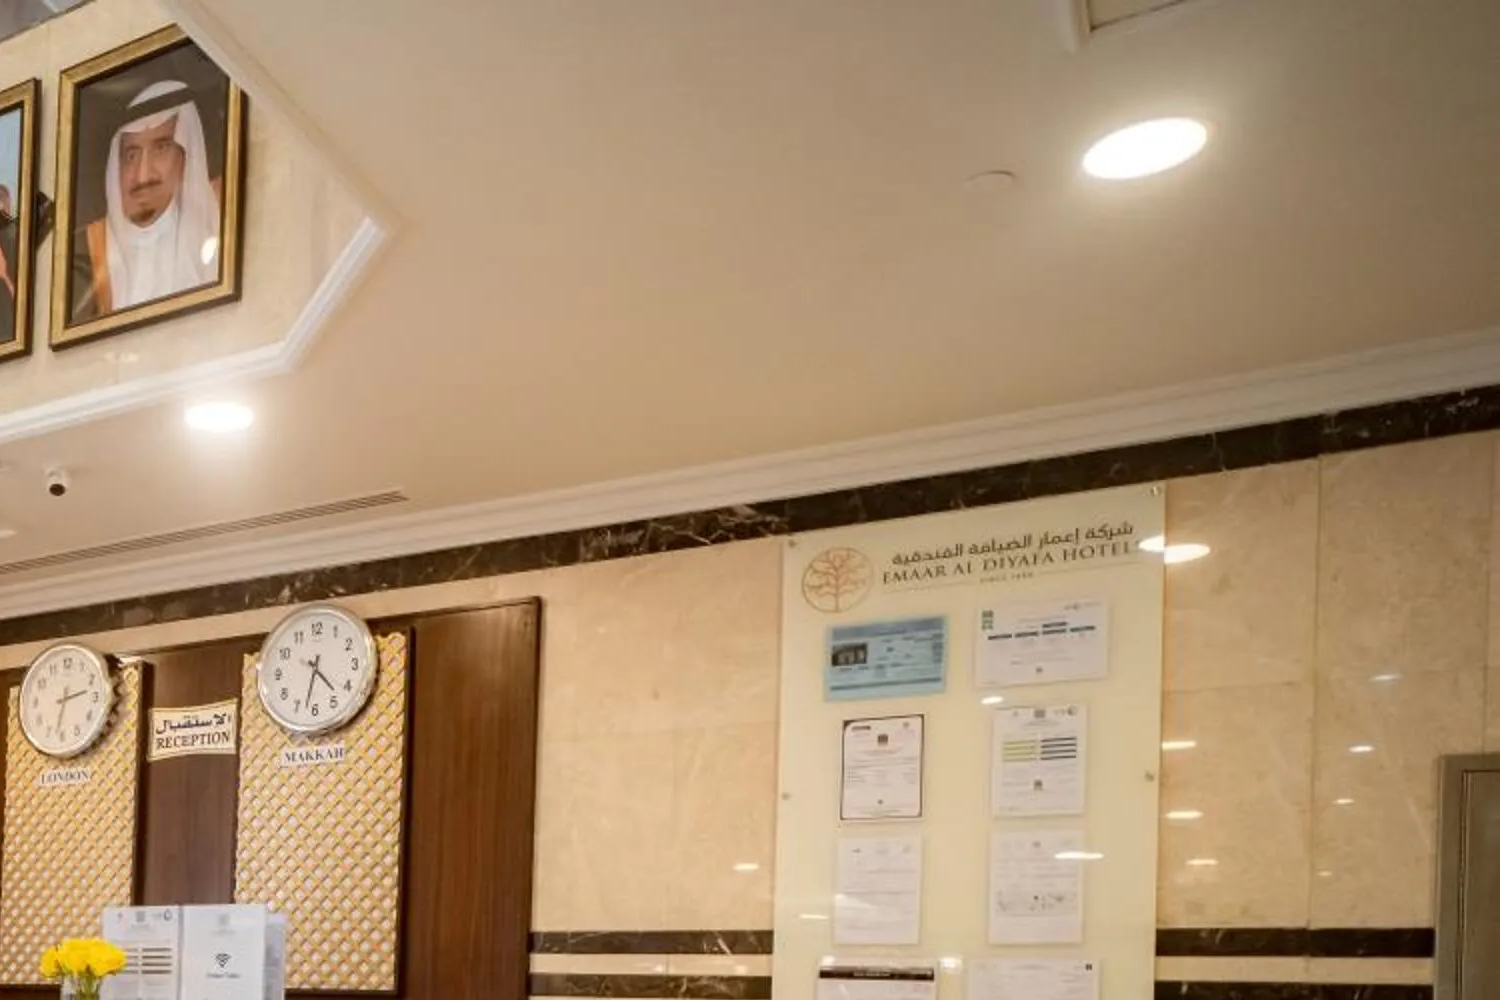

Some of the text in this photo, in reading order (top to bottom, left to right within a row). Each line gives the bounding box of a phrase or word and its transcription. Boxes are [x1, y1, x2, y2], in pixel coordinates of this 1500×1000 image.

[1085, 520, 1133, 541] شركة
[882, 564, 947, 585] EMAAR
[311, 621, 324, 636] 12
[345, 637, 353, 652] 2
[279, 647, 291, 661] 10
[351, 657, 359, 671] 3
[343, 679, 353, 692] 4
[329, 695, 339, 709] 5
[311, 703, 320, 717] 6
[156, 731, 230, 750] RECEPTION
[284, 747, 344, 763] MAKKAH
